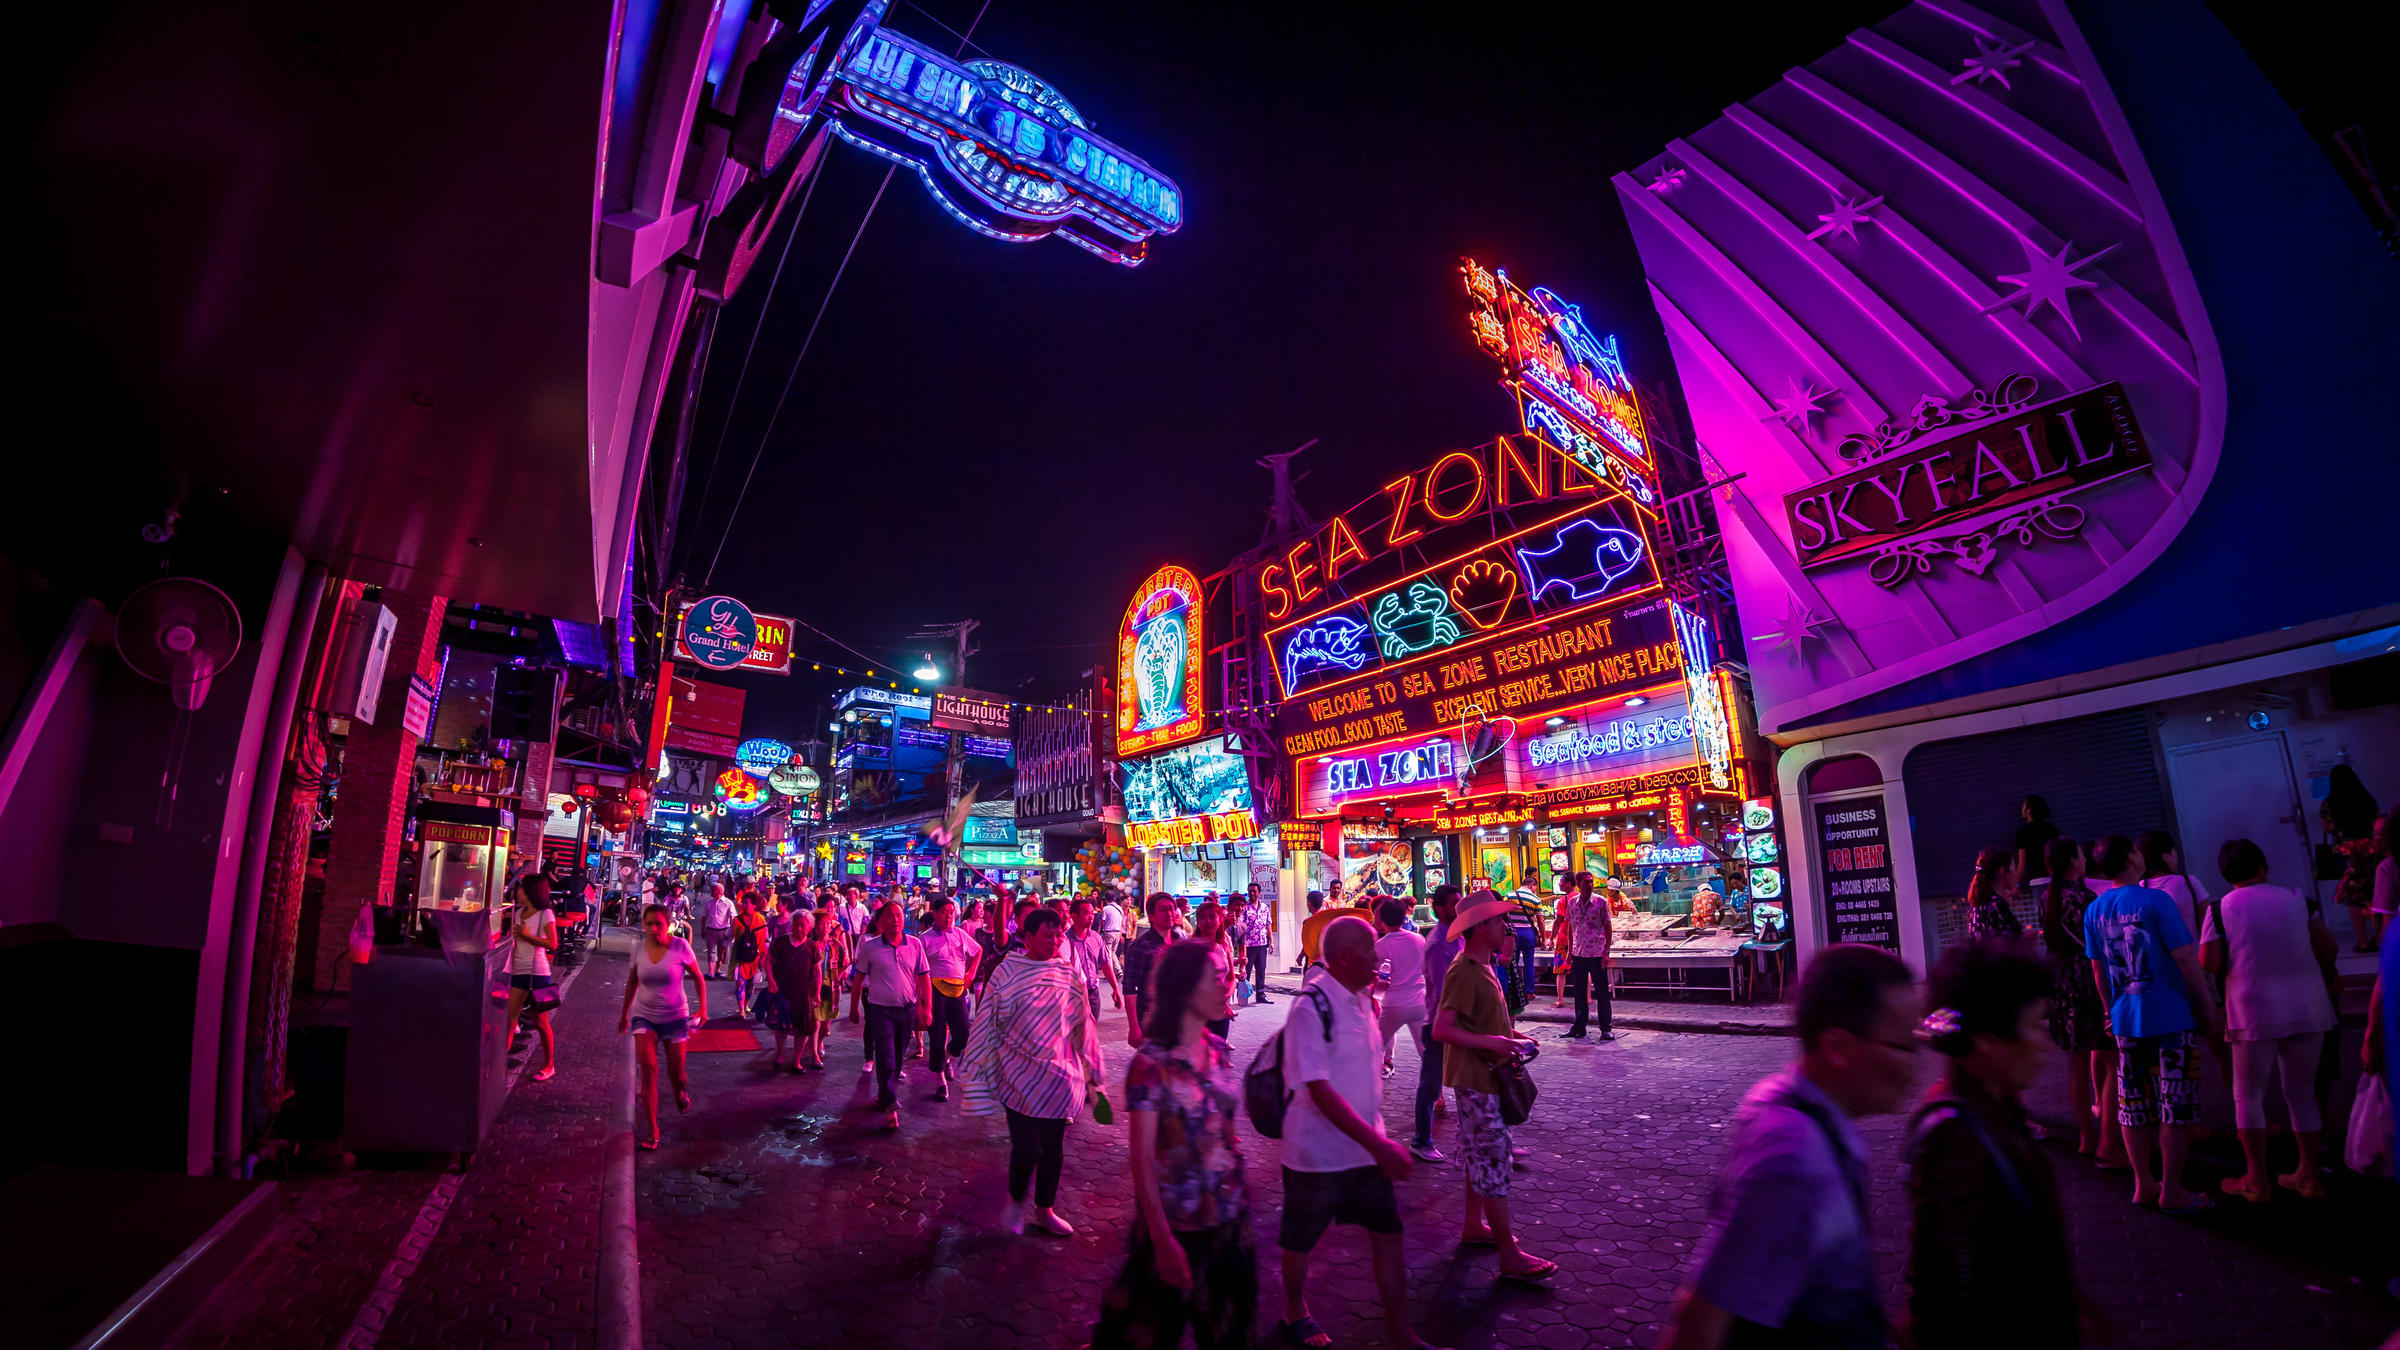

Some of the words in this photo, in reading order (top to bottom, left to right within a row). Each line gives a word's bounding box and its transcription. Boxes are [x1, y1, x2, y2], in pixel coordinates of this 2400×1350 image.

[849, 34, 916, 90] LUE
[914, 62, 979, 117] SKY
[995, 109, 1046, 158] 15
[1066, 136, 1179, 225] STATION
[1518, 316, 1571, 381] SEA
[1794, 408, 2114, 551] SKYFALL
[1261, 515, 1371, 619] SEA
[1128, 570, 1193, 623] LOBSTER
[1147, 593, 1171, 617] POT
[1187, 601, 1199, 643] FRESH
[1623, 604, 1655, 619] ร้านอาหาร
[688, 632, 720, 648] Grand
[723, 641, 750, 653] Hotel
[1187, 647, 1198, 673] SEA
[1308, 687, 1373, 722] WELCOME
[1375, 681, 1397, 704] TO
[1402, 671, 1436, 698] SEA
[1440, 657, 1487, 688] ZONE
[1494, 619, 1613, 674] RESTAURANT
[1186, 678, 1198, 714] FOOD
[1286, 729, 1316, 755] CLEAN
[1374, 710, 1407, 736] TASTE
[1434, 688, 1498, 723] EXCELLENT
[1599, 653, 1636, 685] NICE
[937, 699, 1010, 721] LIGHTHOUSE
[1528, 721, 1620, 767] Seafood
[1623, 720, 1642, 750] &
[773, 769, 816, 783] SIMON
[1328, 758, 1373, 792] SEA
[1379, 742, 1453, 786] ZONE
[1557, 779, 1637, 802] обслуживание
[1616, 801, 1627, 809] NO
[1825, 809, 1876, 825] BUSINESS
[430, 826, 486, 841] POPCORN
[1127, 818, 1205, 848] LOBSTER
[1210, 812, 1257, 840] POT
[1437, 817, 1451, 829] SEA
[1454, 814, 1477, 828] ZONE
[1826, 827, 1879, 841] OPPORTUNITY
[1650, 845, 1704, 862] FRESH
[1828, 848, 1852, 872] FOR
[1855, 844, 1885, 870] RENT
[1863, 877, 1890, 894] UPSTAIRS
